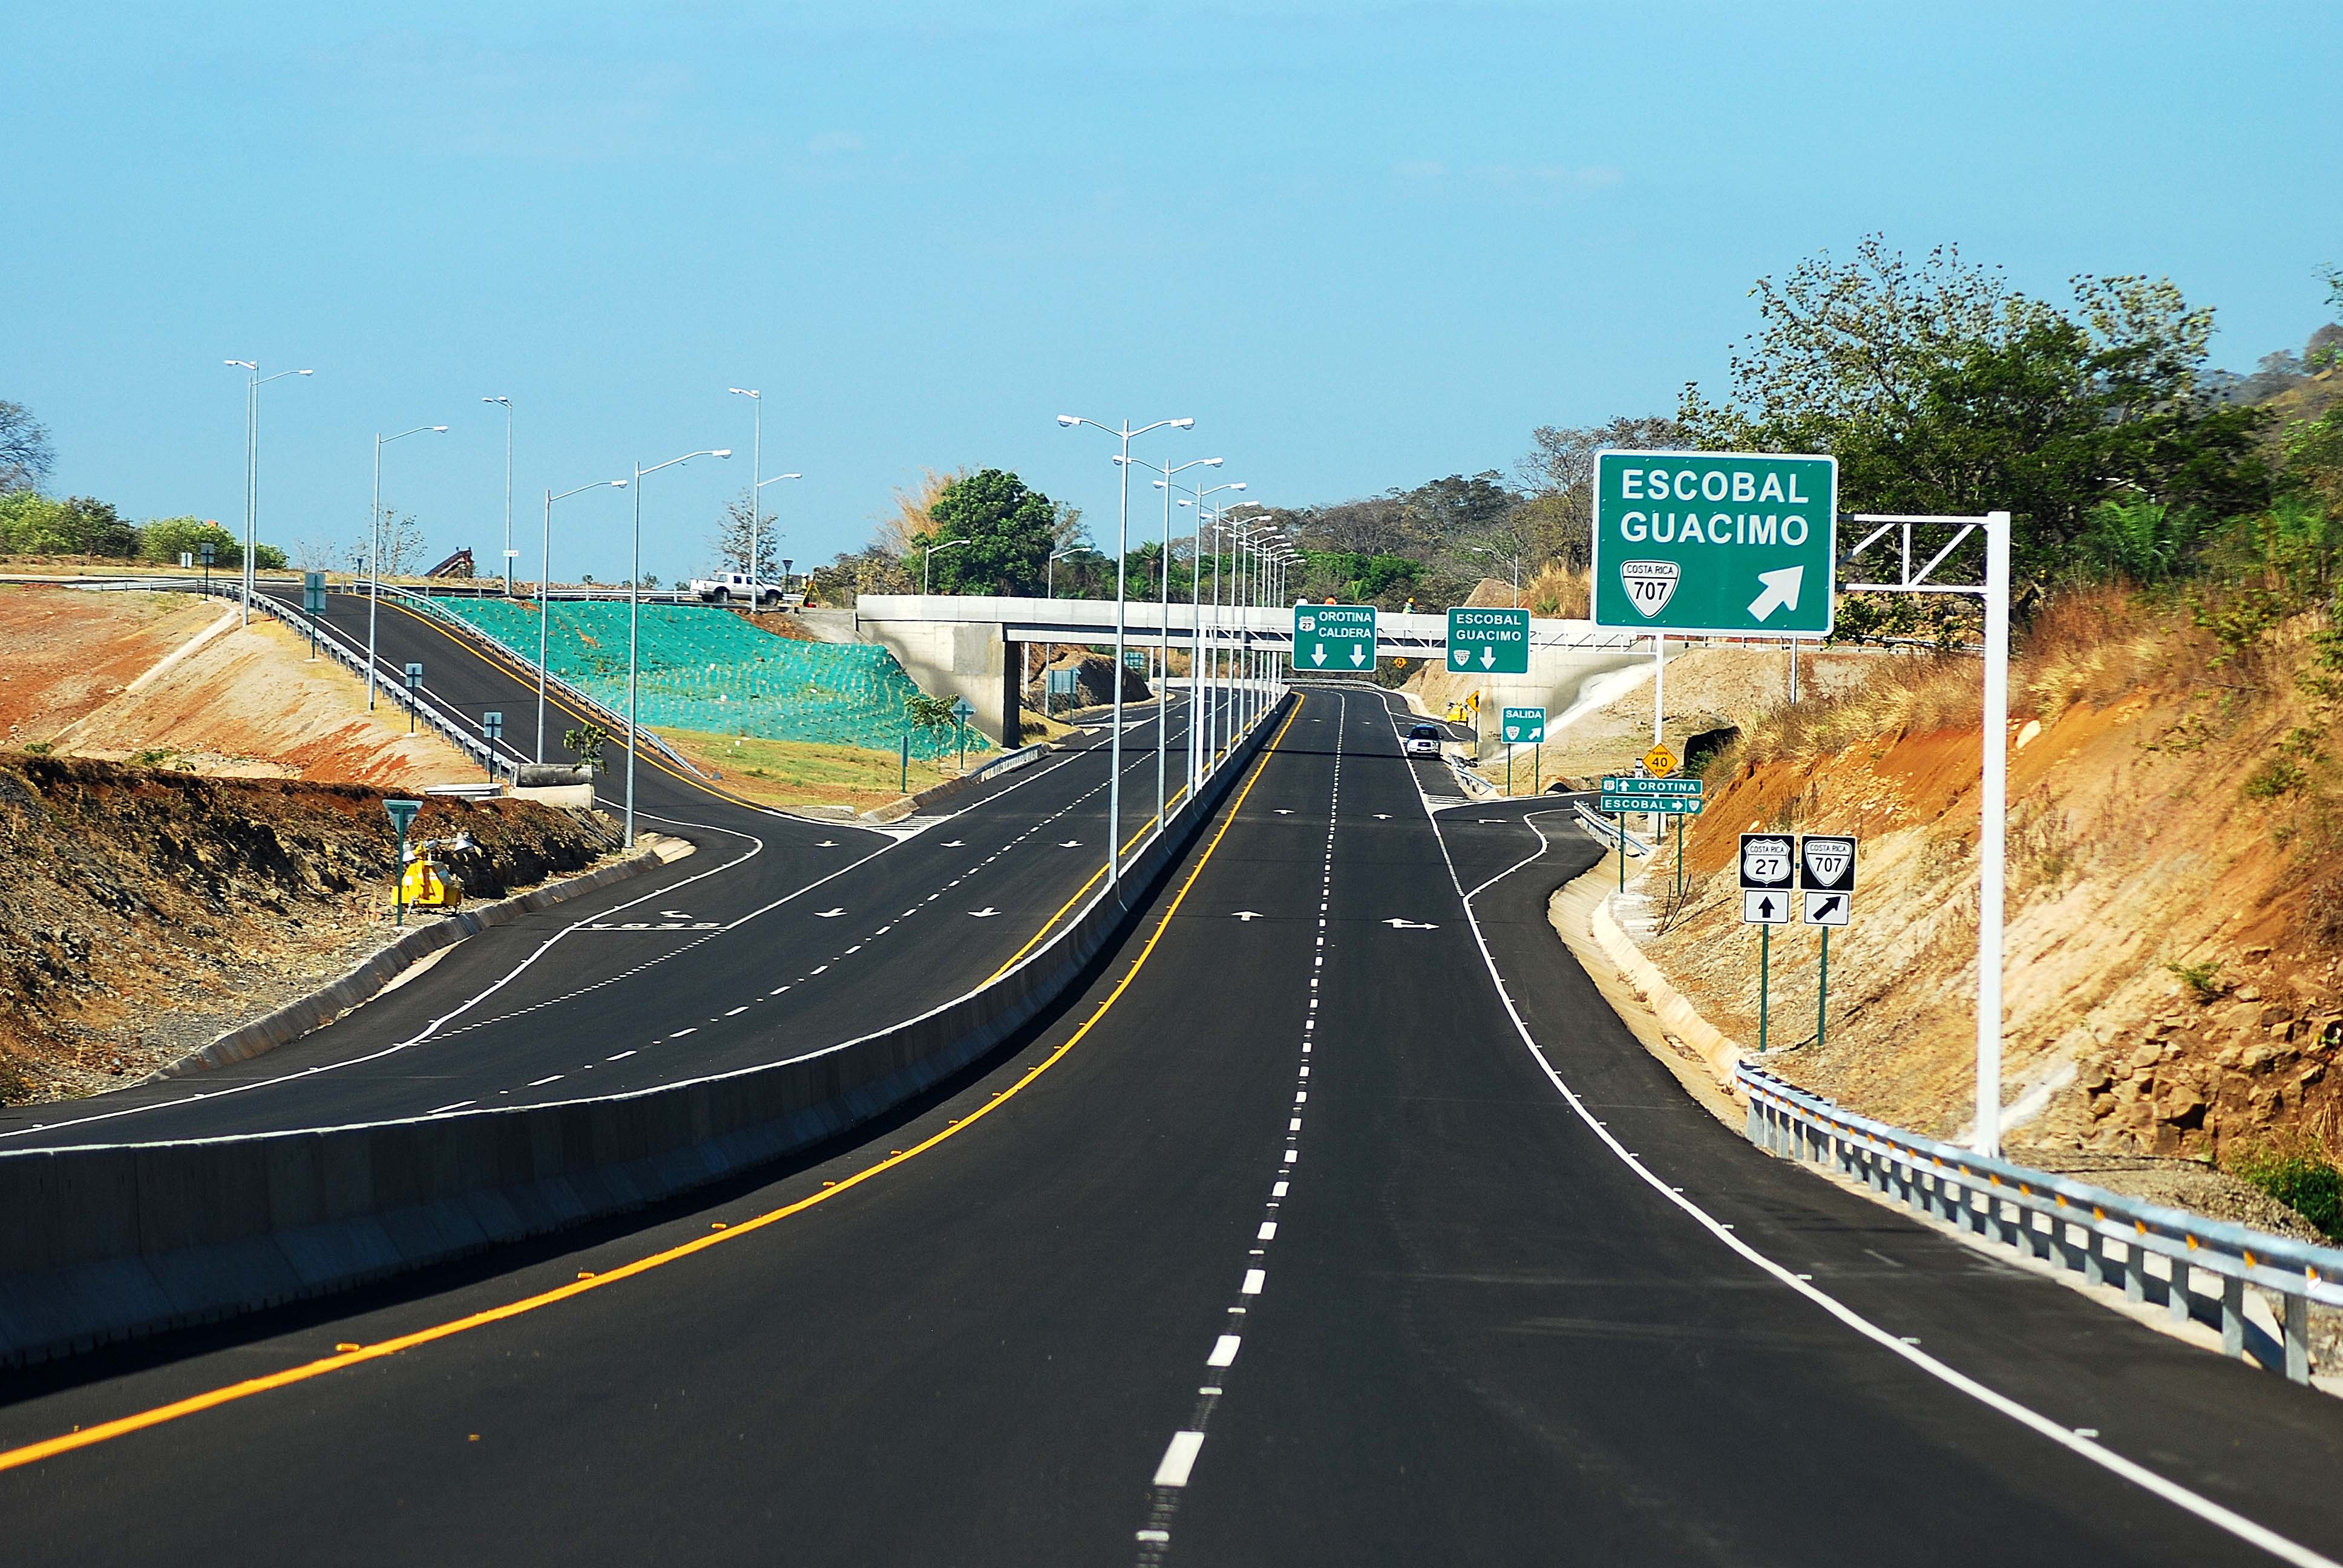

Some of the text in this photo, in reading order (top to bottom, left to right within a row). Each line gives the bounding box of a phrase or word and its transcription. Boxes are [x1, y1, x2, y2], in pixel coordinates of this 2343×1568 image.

[1622, 469, 1809, 503] ESCOBAL
[1620, 511, 1809, 546] GUACIMO
[1627, 564, 1674, 574] COSTA RICA
[1634, 581, 1667, 600] 707
[1319, 611, 1372, 622] OROTINA
[1456, 613, 1522, 625] ESCOBAL
[1319, 627, 1372, 638] CALDERA
[1456, 630, 1521, 641] GUACIMO
[1506, 710, 1542, 719] SALIDA
[1652, 757, 1668, 767] 40
[1638, 782, 1696, 791] OROTINA
[1605, 799, 1666, 809] ESCOBAL
[1755, 859, 1779, 875] 27
[1815, 857, 1842, 872] 707
